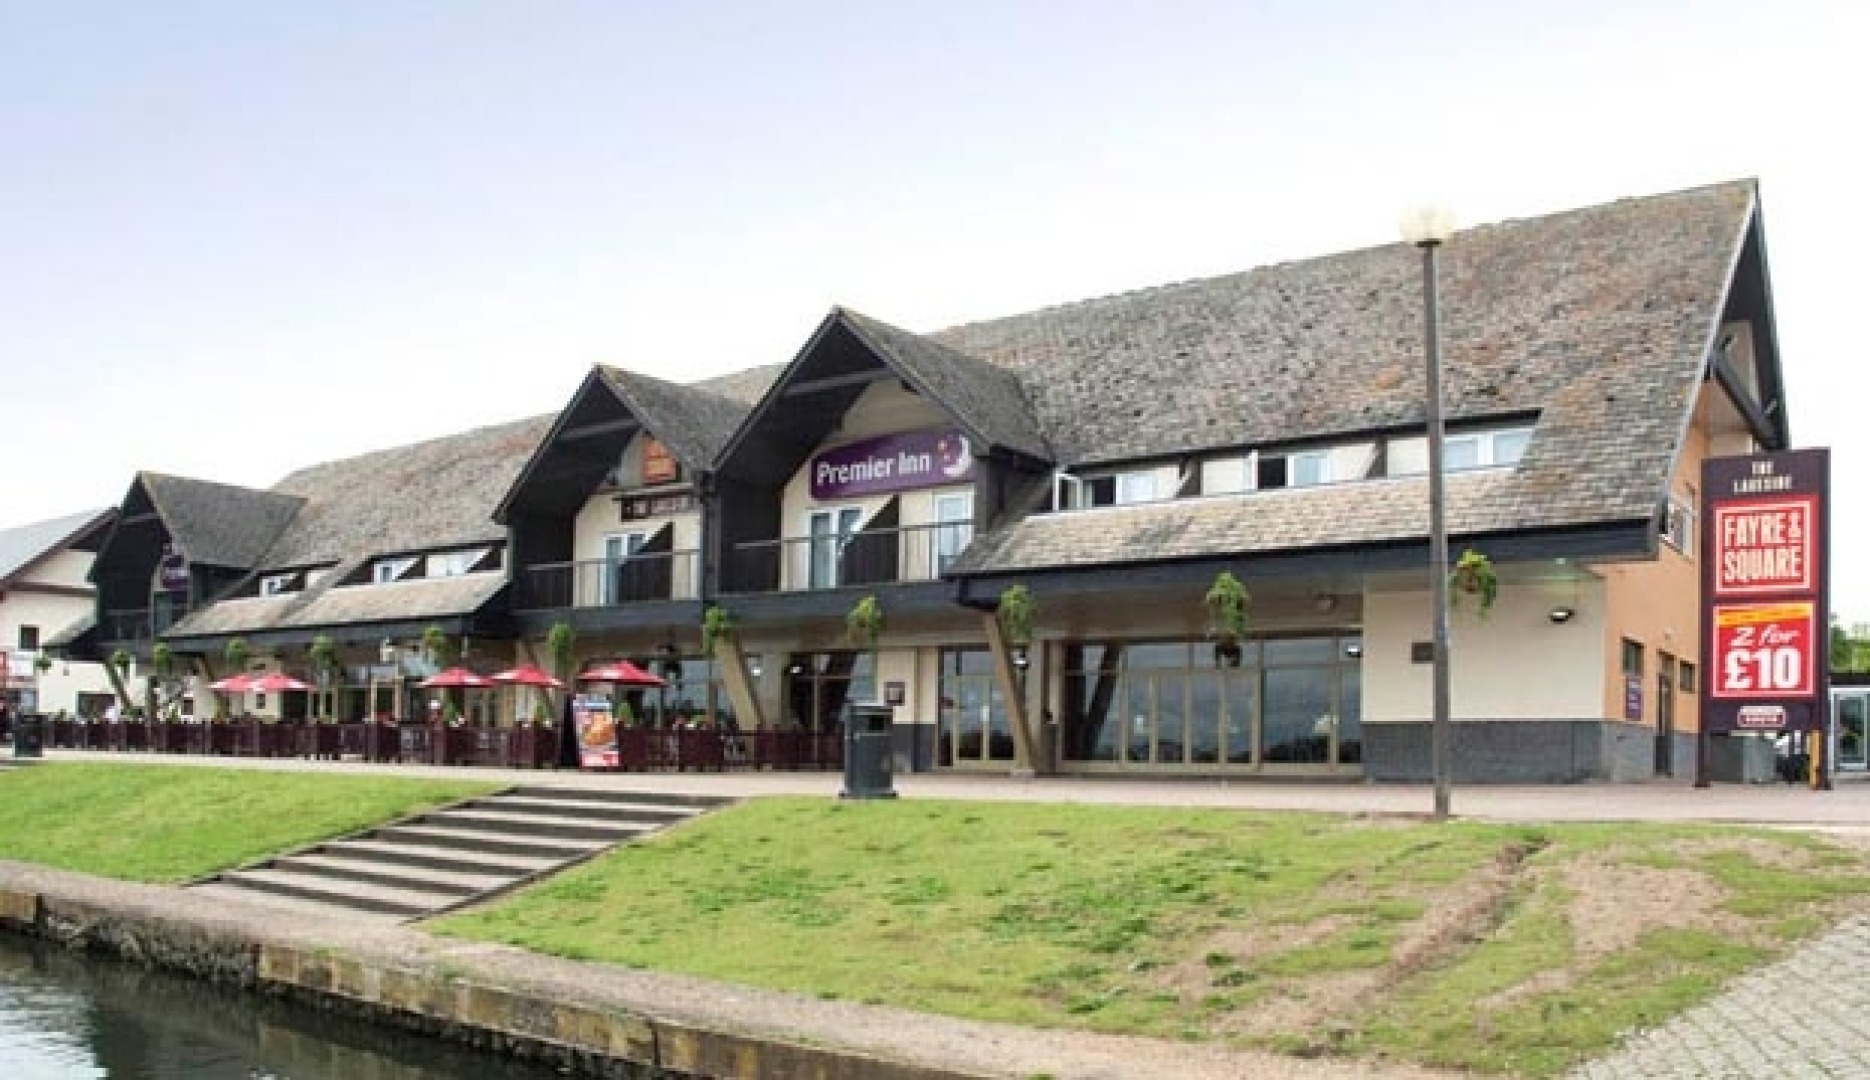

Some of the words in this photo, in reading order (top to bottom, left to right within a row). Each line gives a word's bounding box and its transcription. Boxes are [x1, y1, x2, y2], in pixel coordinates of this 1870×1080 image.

[816, 455, 895, 486] Premier
[898, 451, 931, 475] Inn
[1724, 512, 1787, 547] FAYRE
[1724, 546, 1801, 582] SQUARE
[1729, 627, 1755, 646] 2
[1758, 624, 1801, 646] for
[1723, 646, 1801, 689] £10
